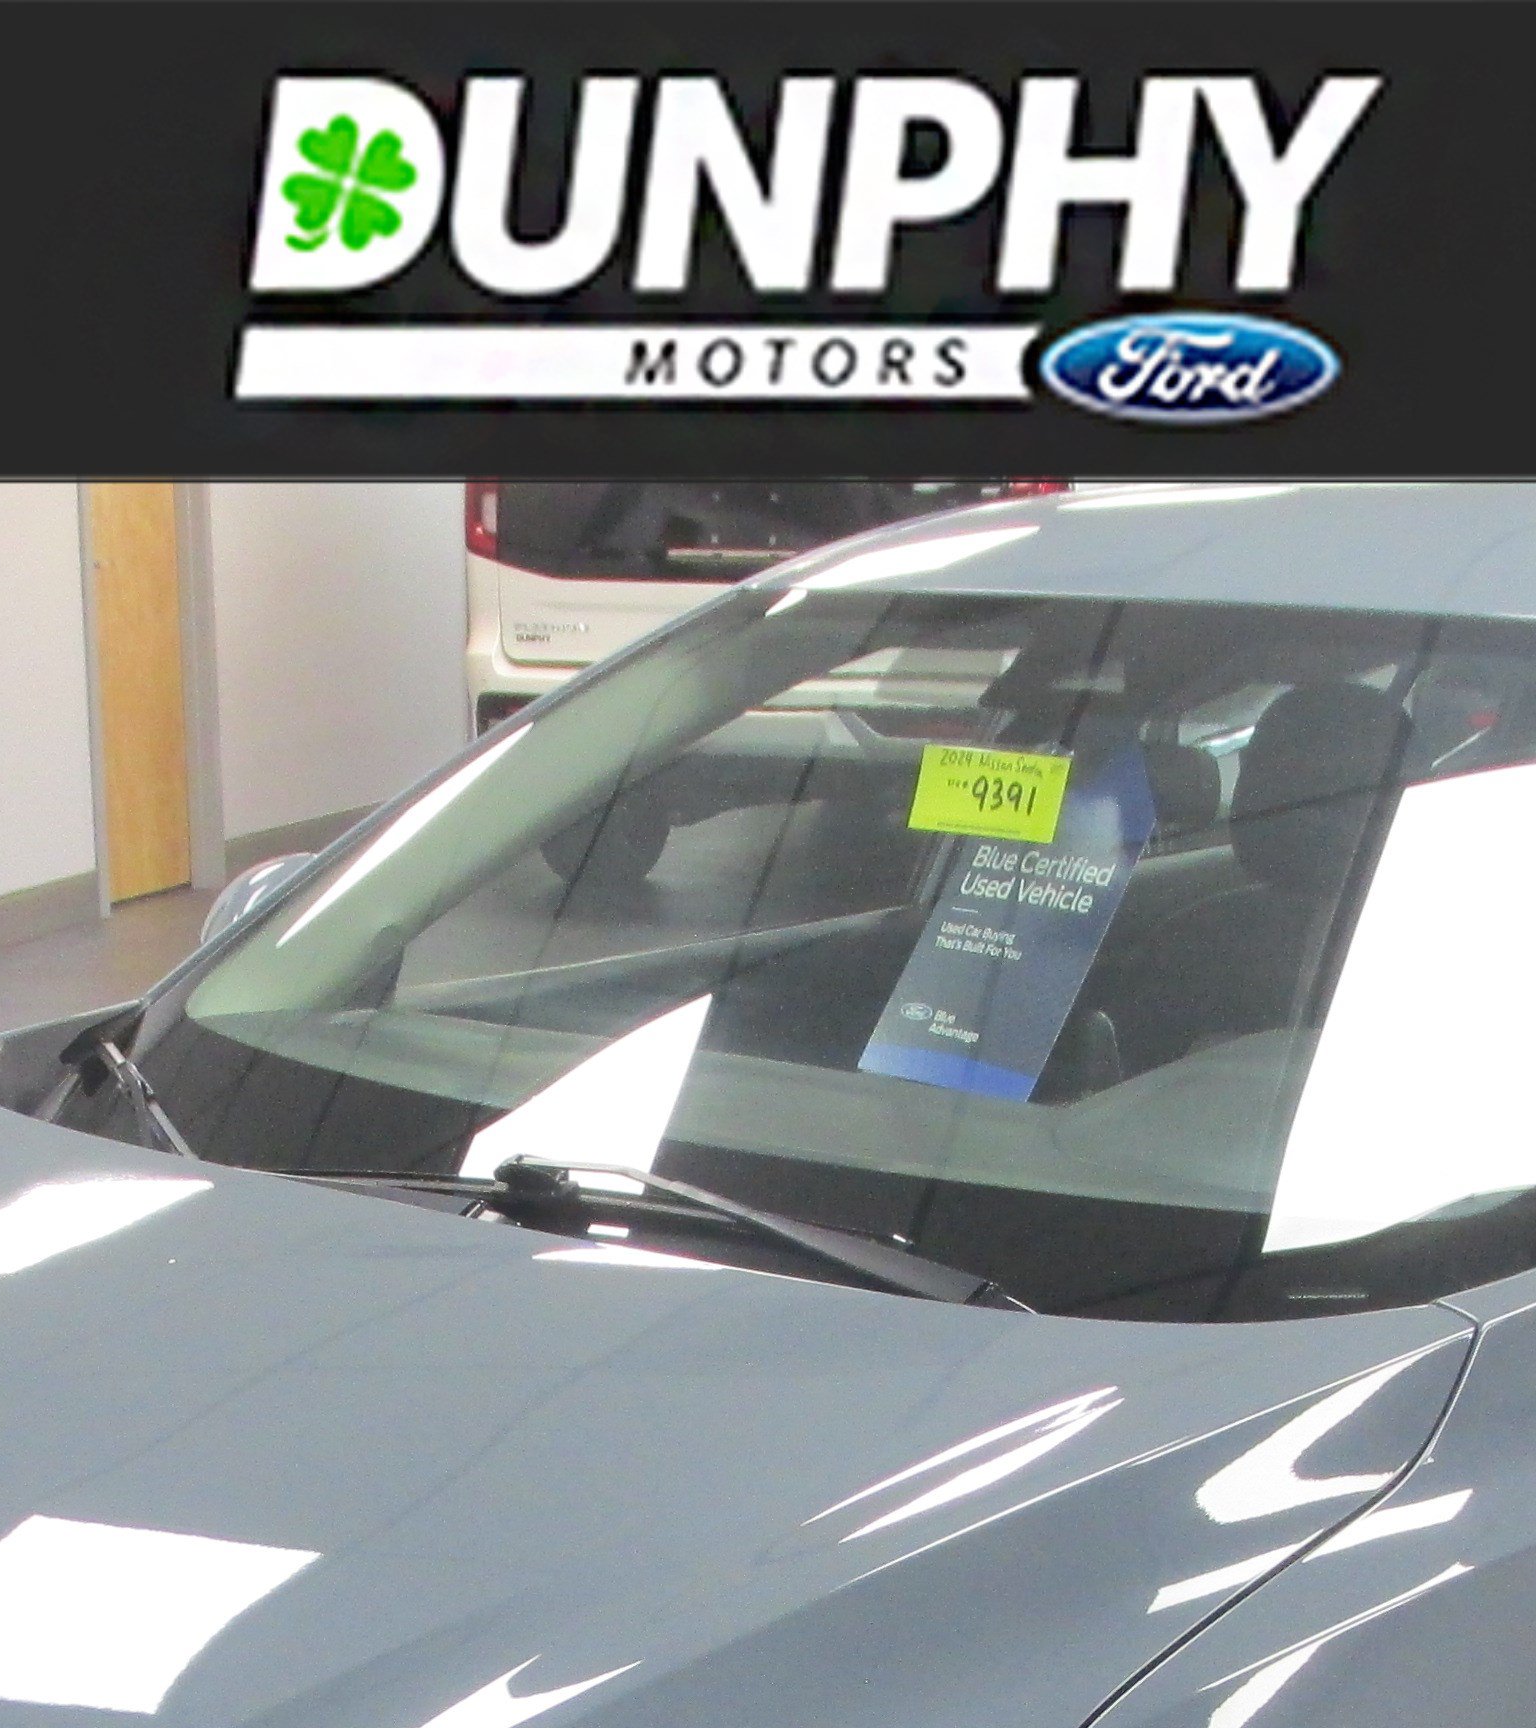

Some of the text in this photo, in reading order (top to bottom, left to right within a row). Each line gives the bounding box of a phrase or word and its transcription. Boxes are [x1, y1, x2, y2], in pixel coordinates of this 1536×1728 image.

[939, 748, 973, 767] 2024
[971, 774, 1037, 816] 9391
[972, 845, 1116, 887] Blue Certified
[960, 871, 1094, 913] Used Vehicle
[940, 921, 966, 936] Used
[965, 924, 982, 938] Car
[1002, 946, 1023, 961] You
